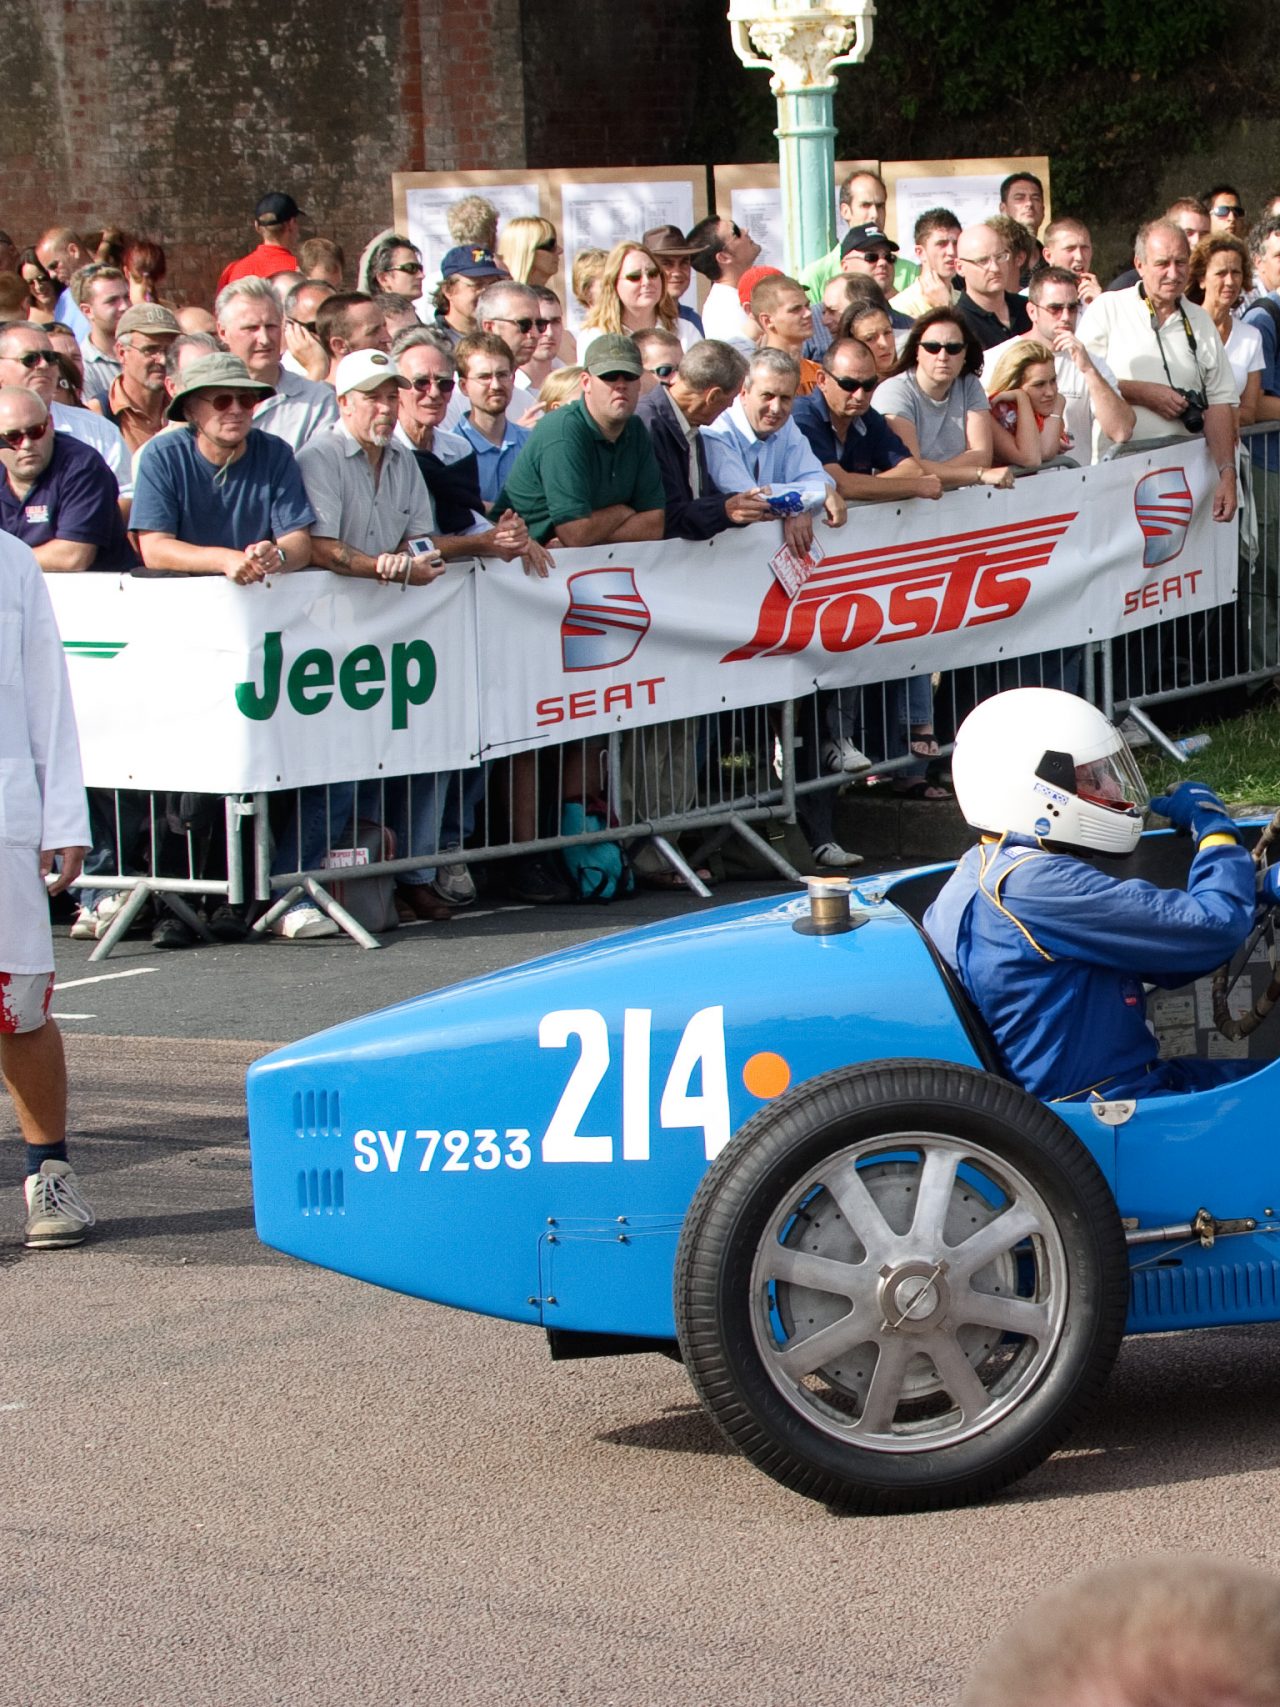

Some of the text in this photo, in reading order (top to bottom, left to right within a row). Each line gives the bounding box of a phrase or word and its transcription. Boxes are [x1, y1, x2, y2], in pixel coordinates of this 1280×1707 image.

[1123, 569, 1203, 615] SEAT
[235, 631, 437, 730] Jeep
[536, 677, 665, 726] SEAT
[538, 1005, 732, 1163] 214
[354, 1128, 532, 1173] SV 7233
